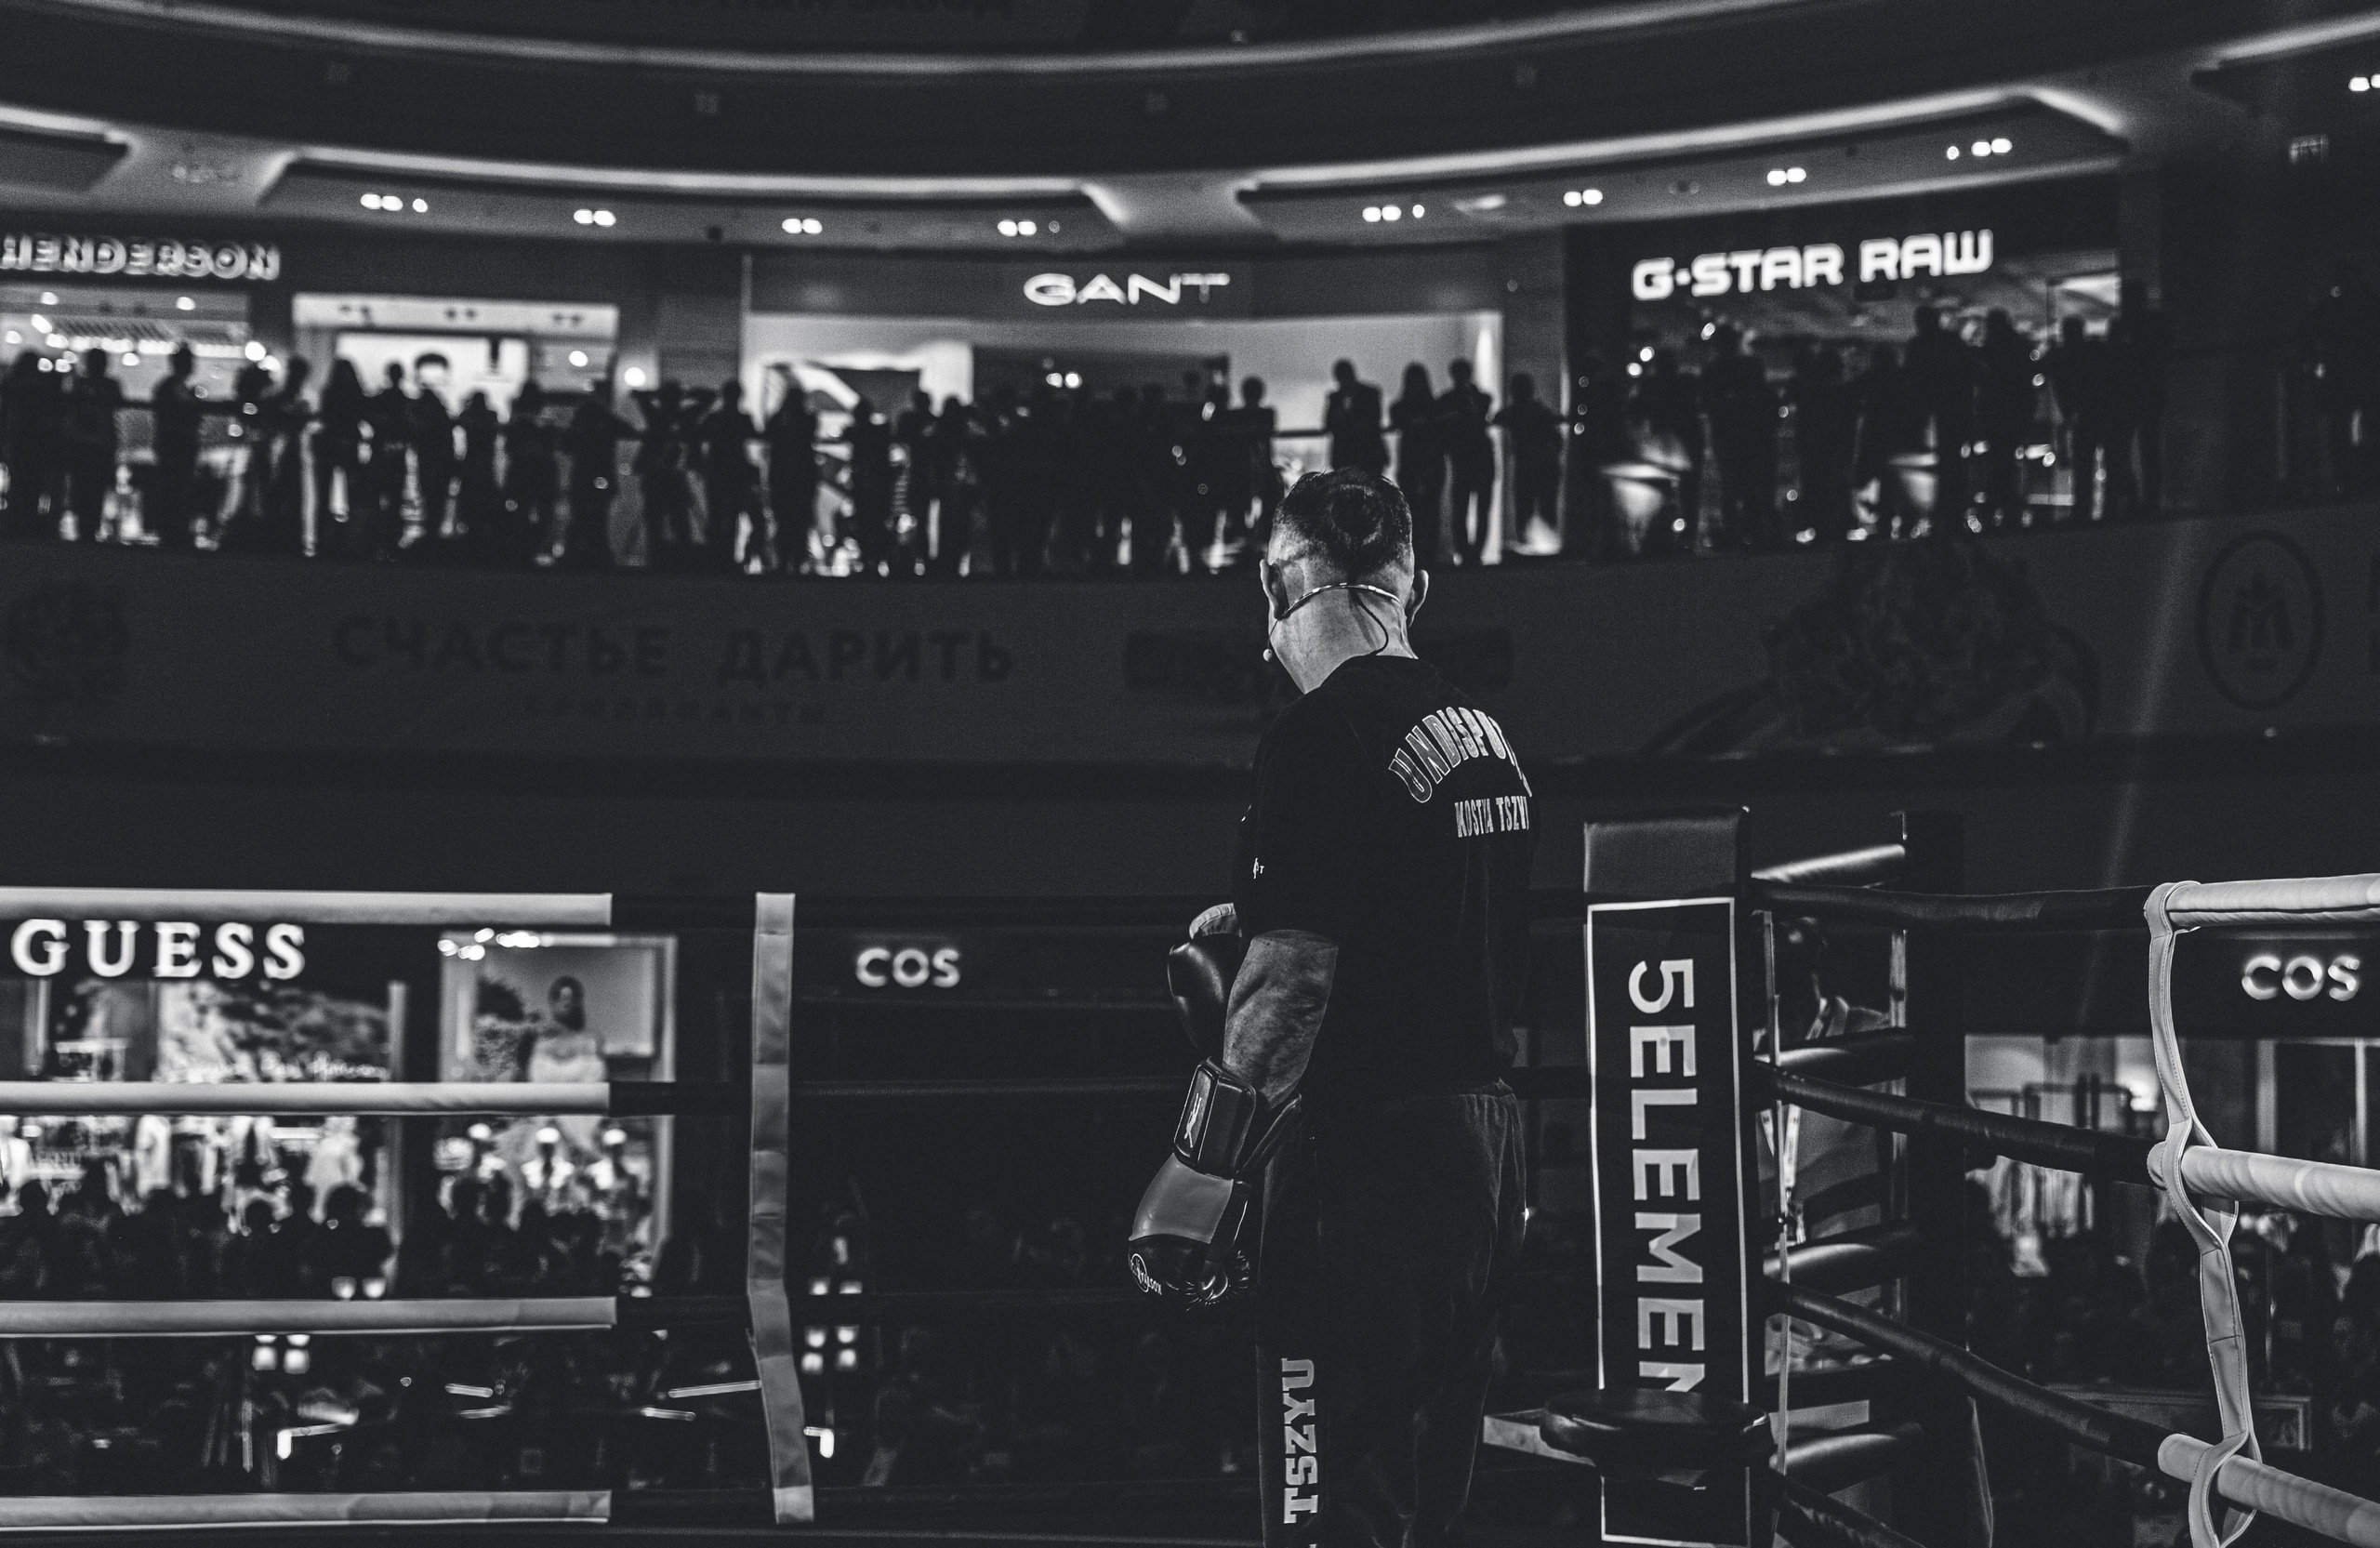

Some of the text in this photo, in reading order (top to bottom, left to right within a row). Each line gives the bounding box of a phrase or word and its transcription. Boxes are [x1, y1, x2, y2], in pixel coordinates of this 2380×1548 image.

[0, 233, 283, 286] HENDERSON
[1859, 229, 1994, 283] RAW
[1023, 271, 1231, 307] GANT
[331, 614, 1015, 689] СЧАСТЬЕ ДАРИТЬ
[1387, 705, 1534, 804] UNDISPU
[1495, 795, 1530, 832] TSZY
[11, 918, 305, 980] GUESS
[856, 946, 960, 987] COS
[2241, 953, 2360, 1000] COS
[1627, 958, 1706, 1395] 5ELEMEN
[1281, 1357, 1319, 1525] TSZYU
